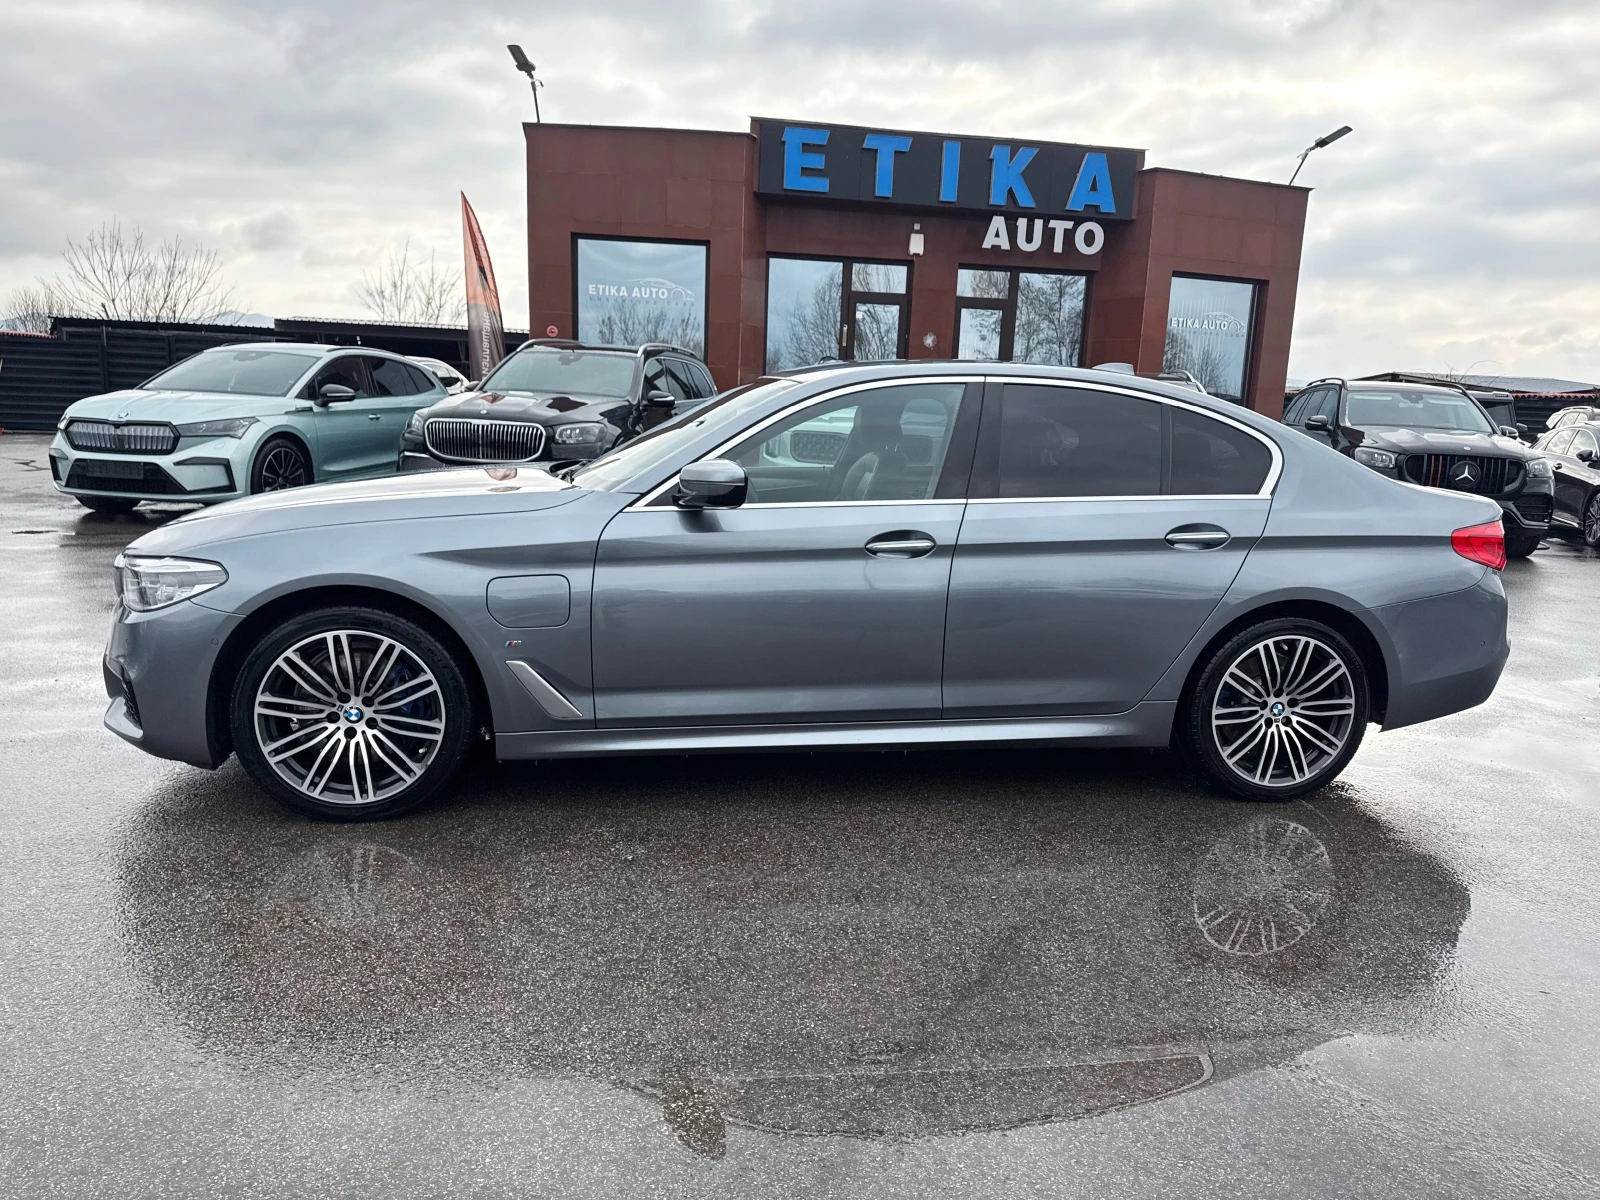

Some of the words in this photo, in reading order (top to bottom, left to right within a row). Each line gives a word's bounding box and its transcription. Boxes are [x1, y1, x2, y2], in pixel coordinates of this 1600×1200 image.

[782, 126, 1116, 214] ETIKA
[982, 215, 1105, 256] AUTO
[588, 284, 628, 297] ETIKA
[632, 286, 668, 299] AUTO
[1171, 317, 1200, 329] ETIKA
[1202, 320, 1228, 330] AUTO
